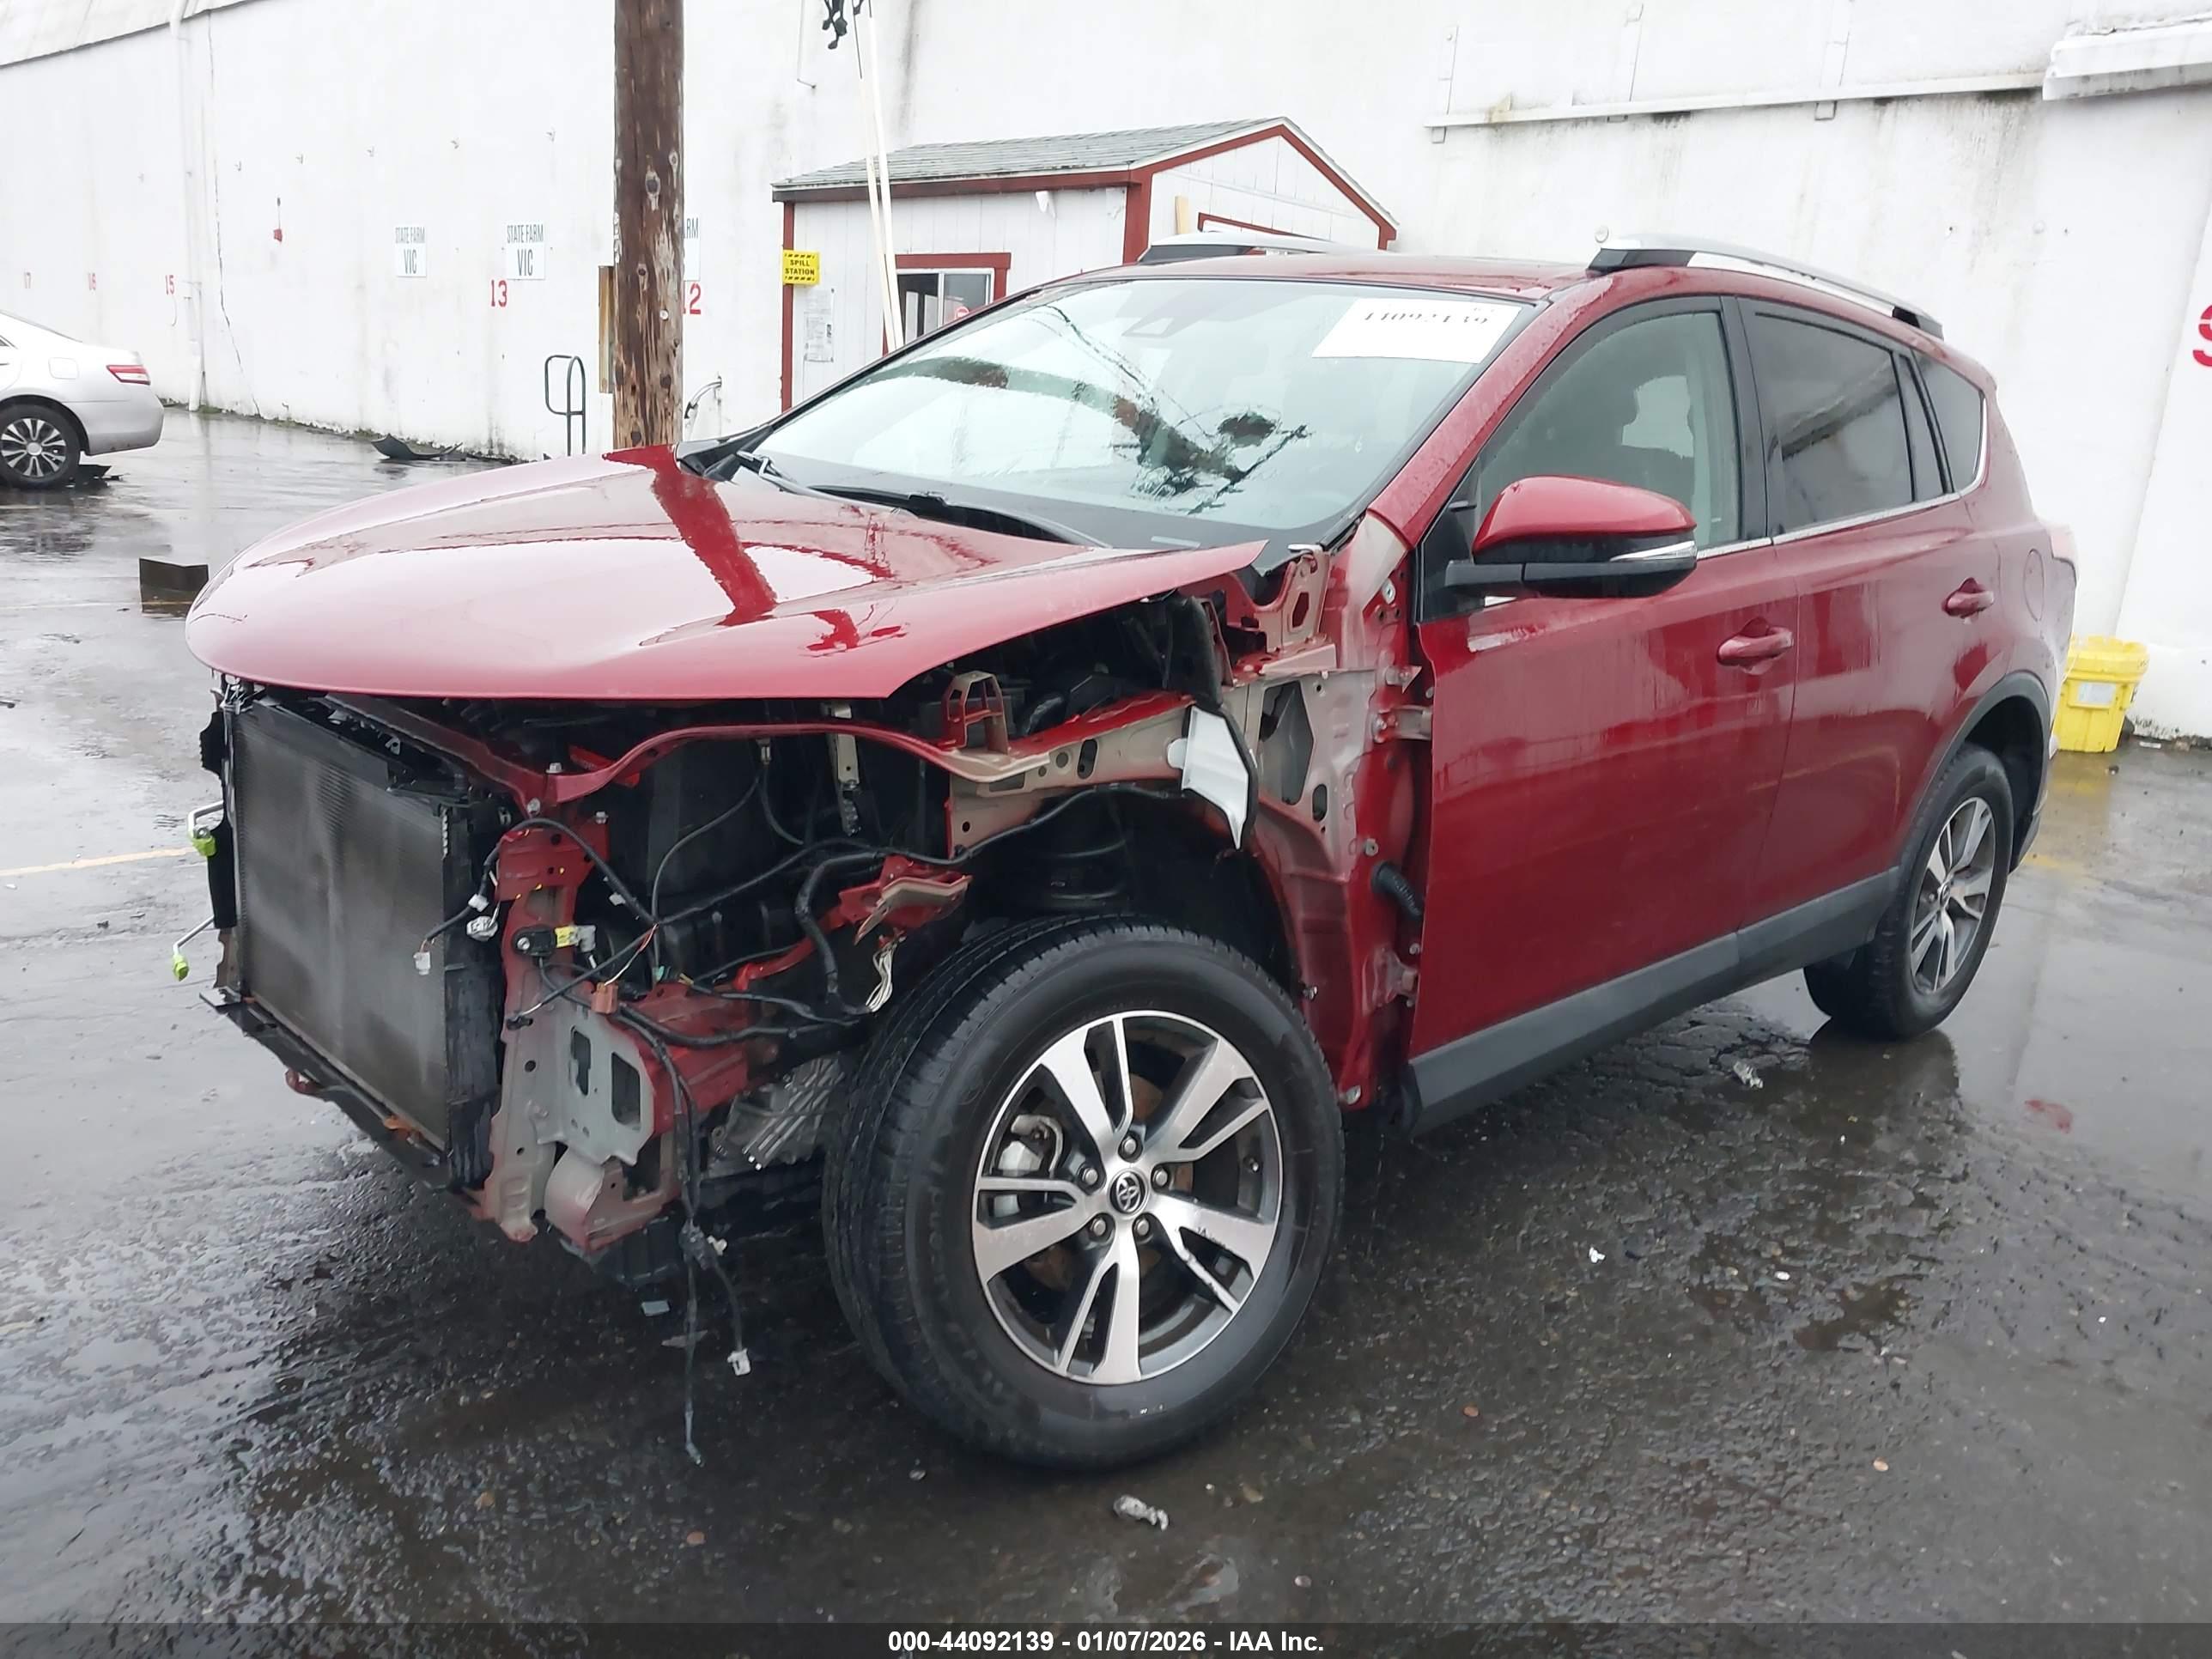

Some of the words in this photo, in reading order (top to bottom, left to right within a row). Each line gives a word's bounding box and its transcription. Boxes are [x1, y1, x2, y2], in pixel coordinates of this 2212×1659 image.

[507, 224, 525, 244] STATE
[526, 223, 544, 243] FARM
[404, 249, 417, 274] VIC
[517, 248, 533, 276] VIC
[165, 274, 175, 295] 15
[490, 279, 507, 307] 13
